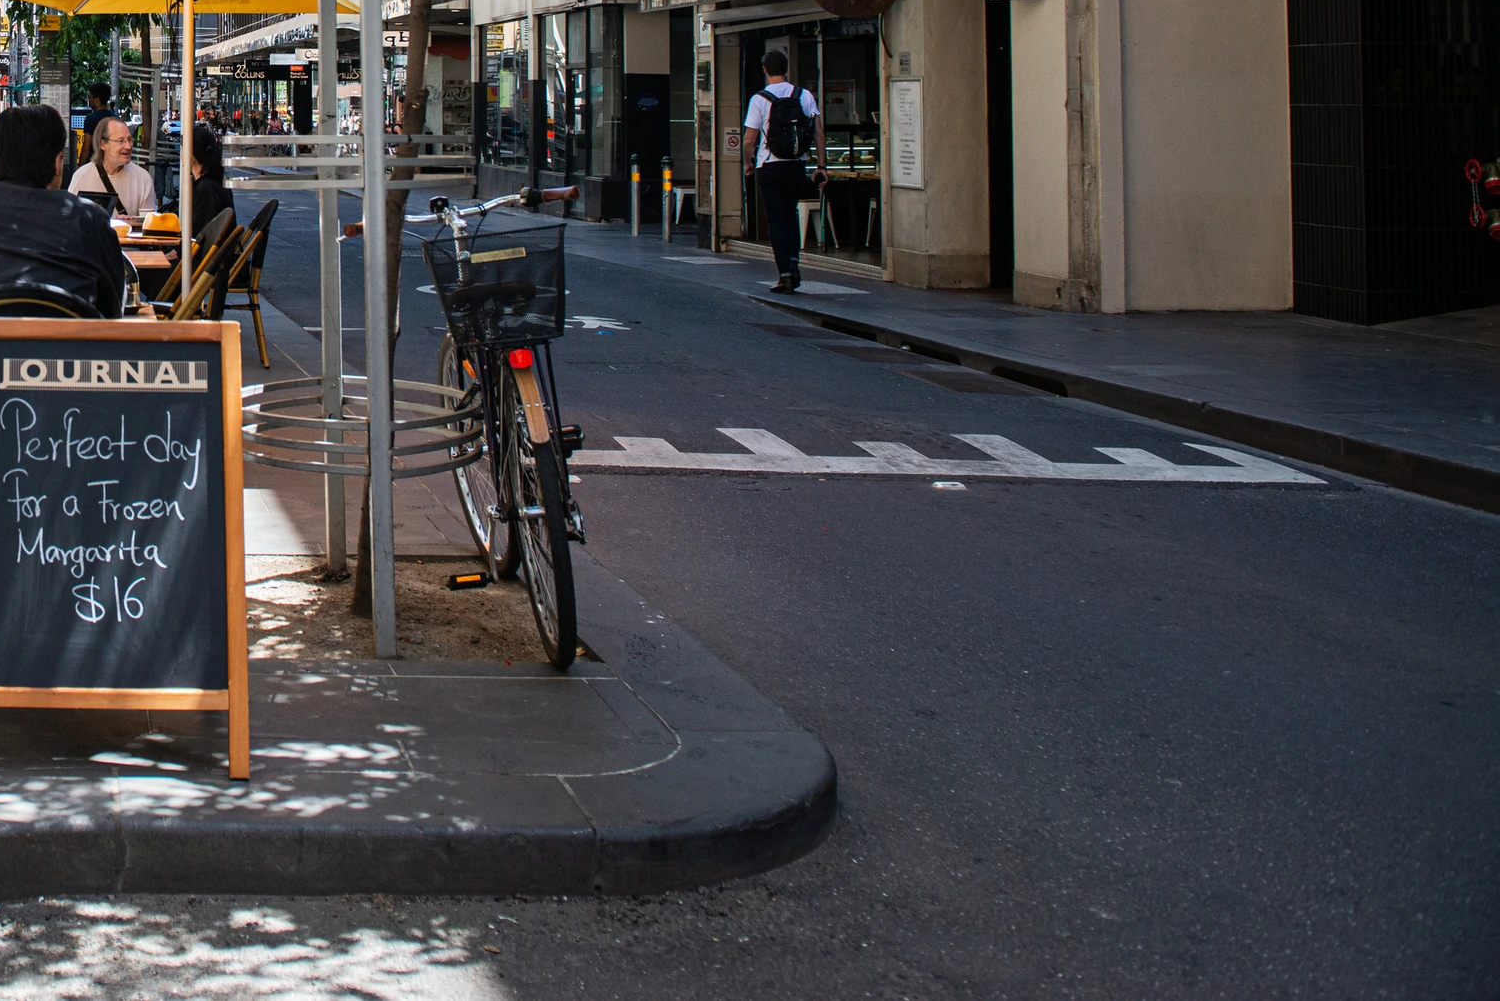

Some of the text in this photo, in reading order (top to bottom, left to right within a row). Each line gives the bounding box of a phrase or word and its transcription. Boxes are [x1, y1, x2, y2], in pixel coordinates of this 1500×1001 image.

[234, 68, 265, 80] COLLINS
[236, 64, 246, 73] 27
[0, 397, 202, 490] Perfect day
[62, 494, 81, 517] a
[16, 528, 167, 579] Margarita
[71, 575, 147, 624] $16
